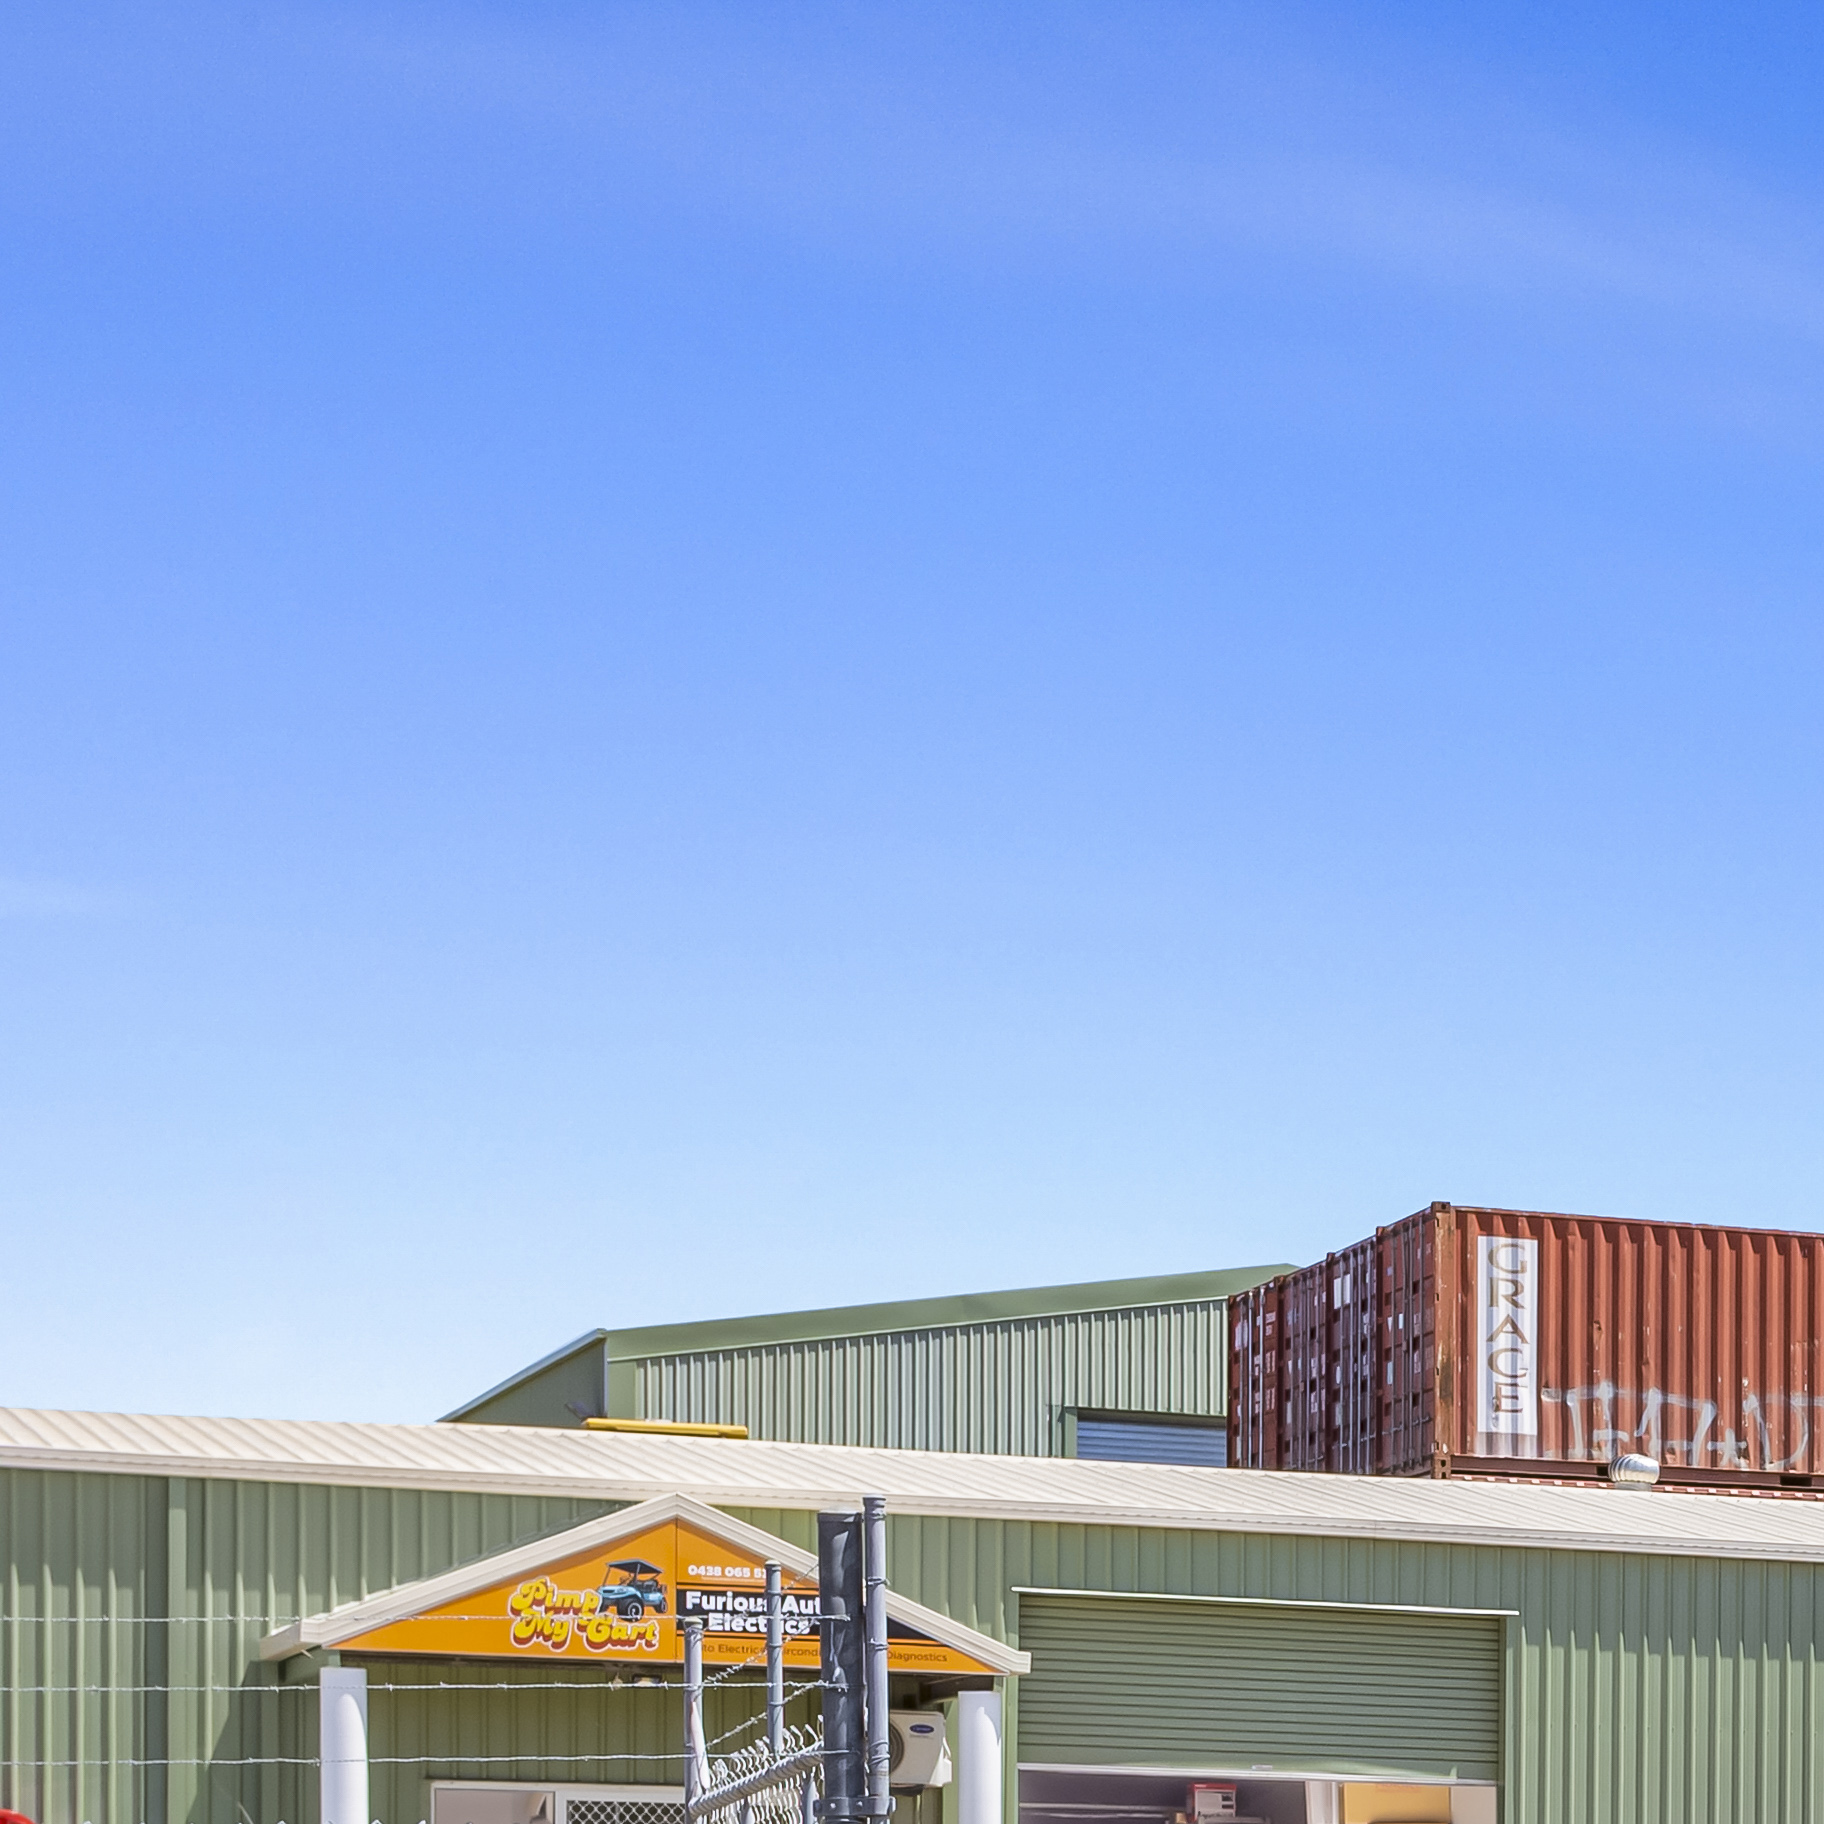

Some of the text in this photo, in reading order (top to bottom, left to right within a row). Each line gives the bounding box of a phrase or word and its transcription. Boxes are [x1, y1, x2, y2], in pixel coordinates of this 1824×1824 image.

[1487, 1242, 1530, 1414] GRACE
[687, 1564, 722, 1578] 0438
[509, 1577, 601, 1617] Pimp
[686, 1591, 821, 1615] Furiou Aut
[512, 1608, 570, 1651] My
[708, 1612, 811, 1635] Electics
